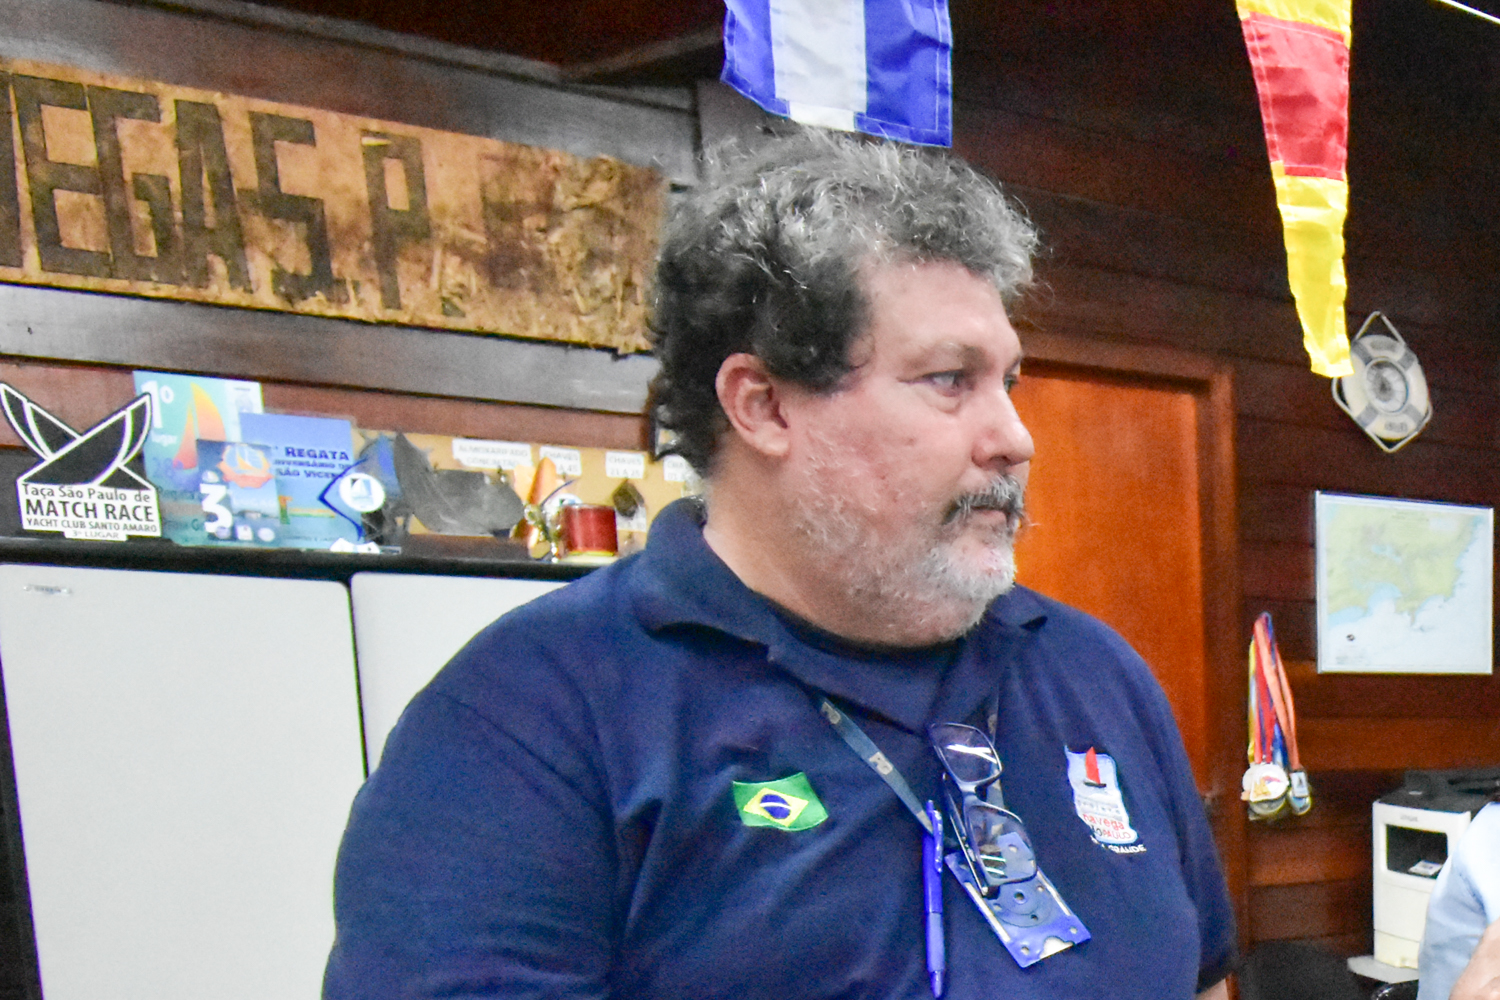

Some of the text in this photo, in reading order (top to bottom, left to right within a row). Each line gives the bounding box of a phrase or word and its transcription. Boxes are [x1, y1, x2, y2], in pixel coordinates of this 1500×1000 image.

[284, 446, 350, 461] REGATA
[22, 484, 55, 499] Taça
[59, 485, 84, 499] São
[88, 487, 128, 501] Paulo
[134, 490, 151, 503] de
[26, 498, 155, 523] MATCH RACE
[199, 483, 233, 534] 3
[26, 517, 59, 528] YACHT
[61, 519, 86, 530] CLUB
[88, 520, 121, 532] SANTO
[122, 522, 158, 533] AMARO
[1082, 813, 1125, 831] navega
